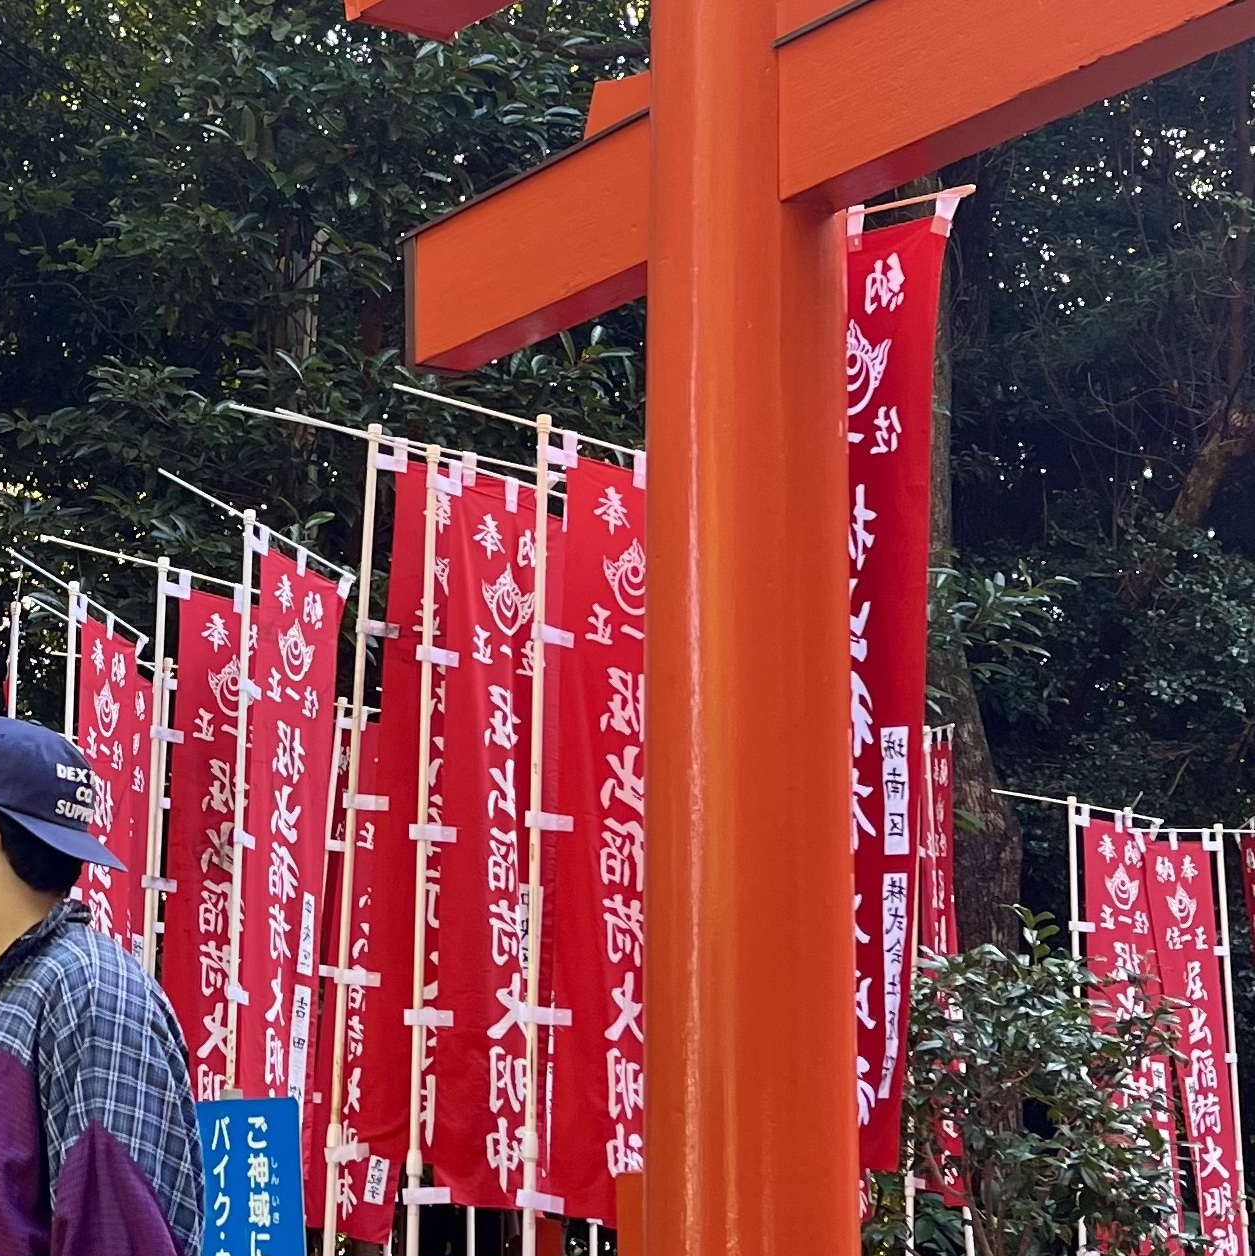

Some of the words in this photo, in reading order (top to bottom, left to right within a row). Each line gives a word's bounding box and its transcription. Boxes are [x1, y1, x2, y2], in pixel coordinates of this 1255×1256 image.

[1154, 854, 1199, 885] 奉納
[1165, 925, 1209, 952] 正一位
